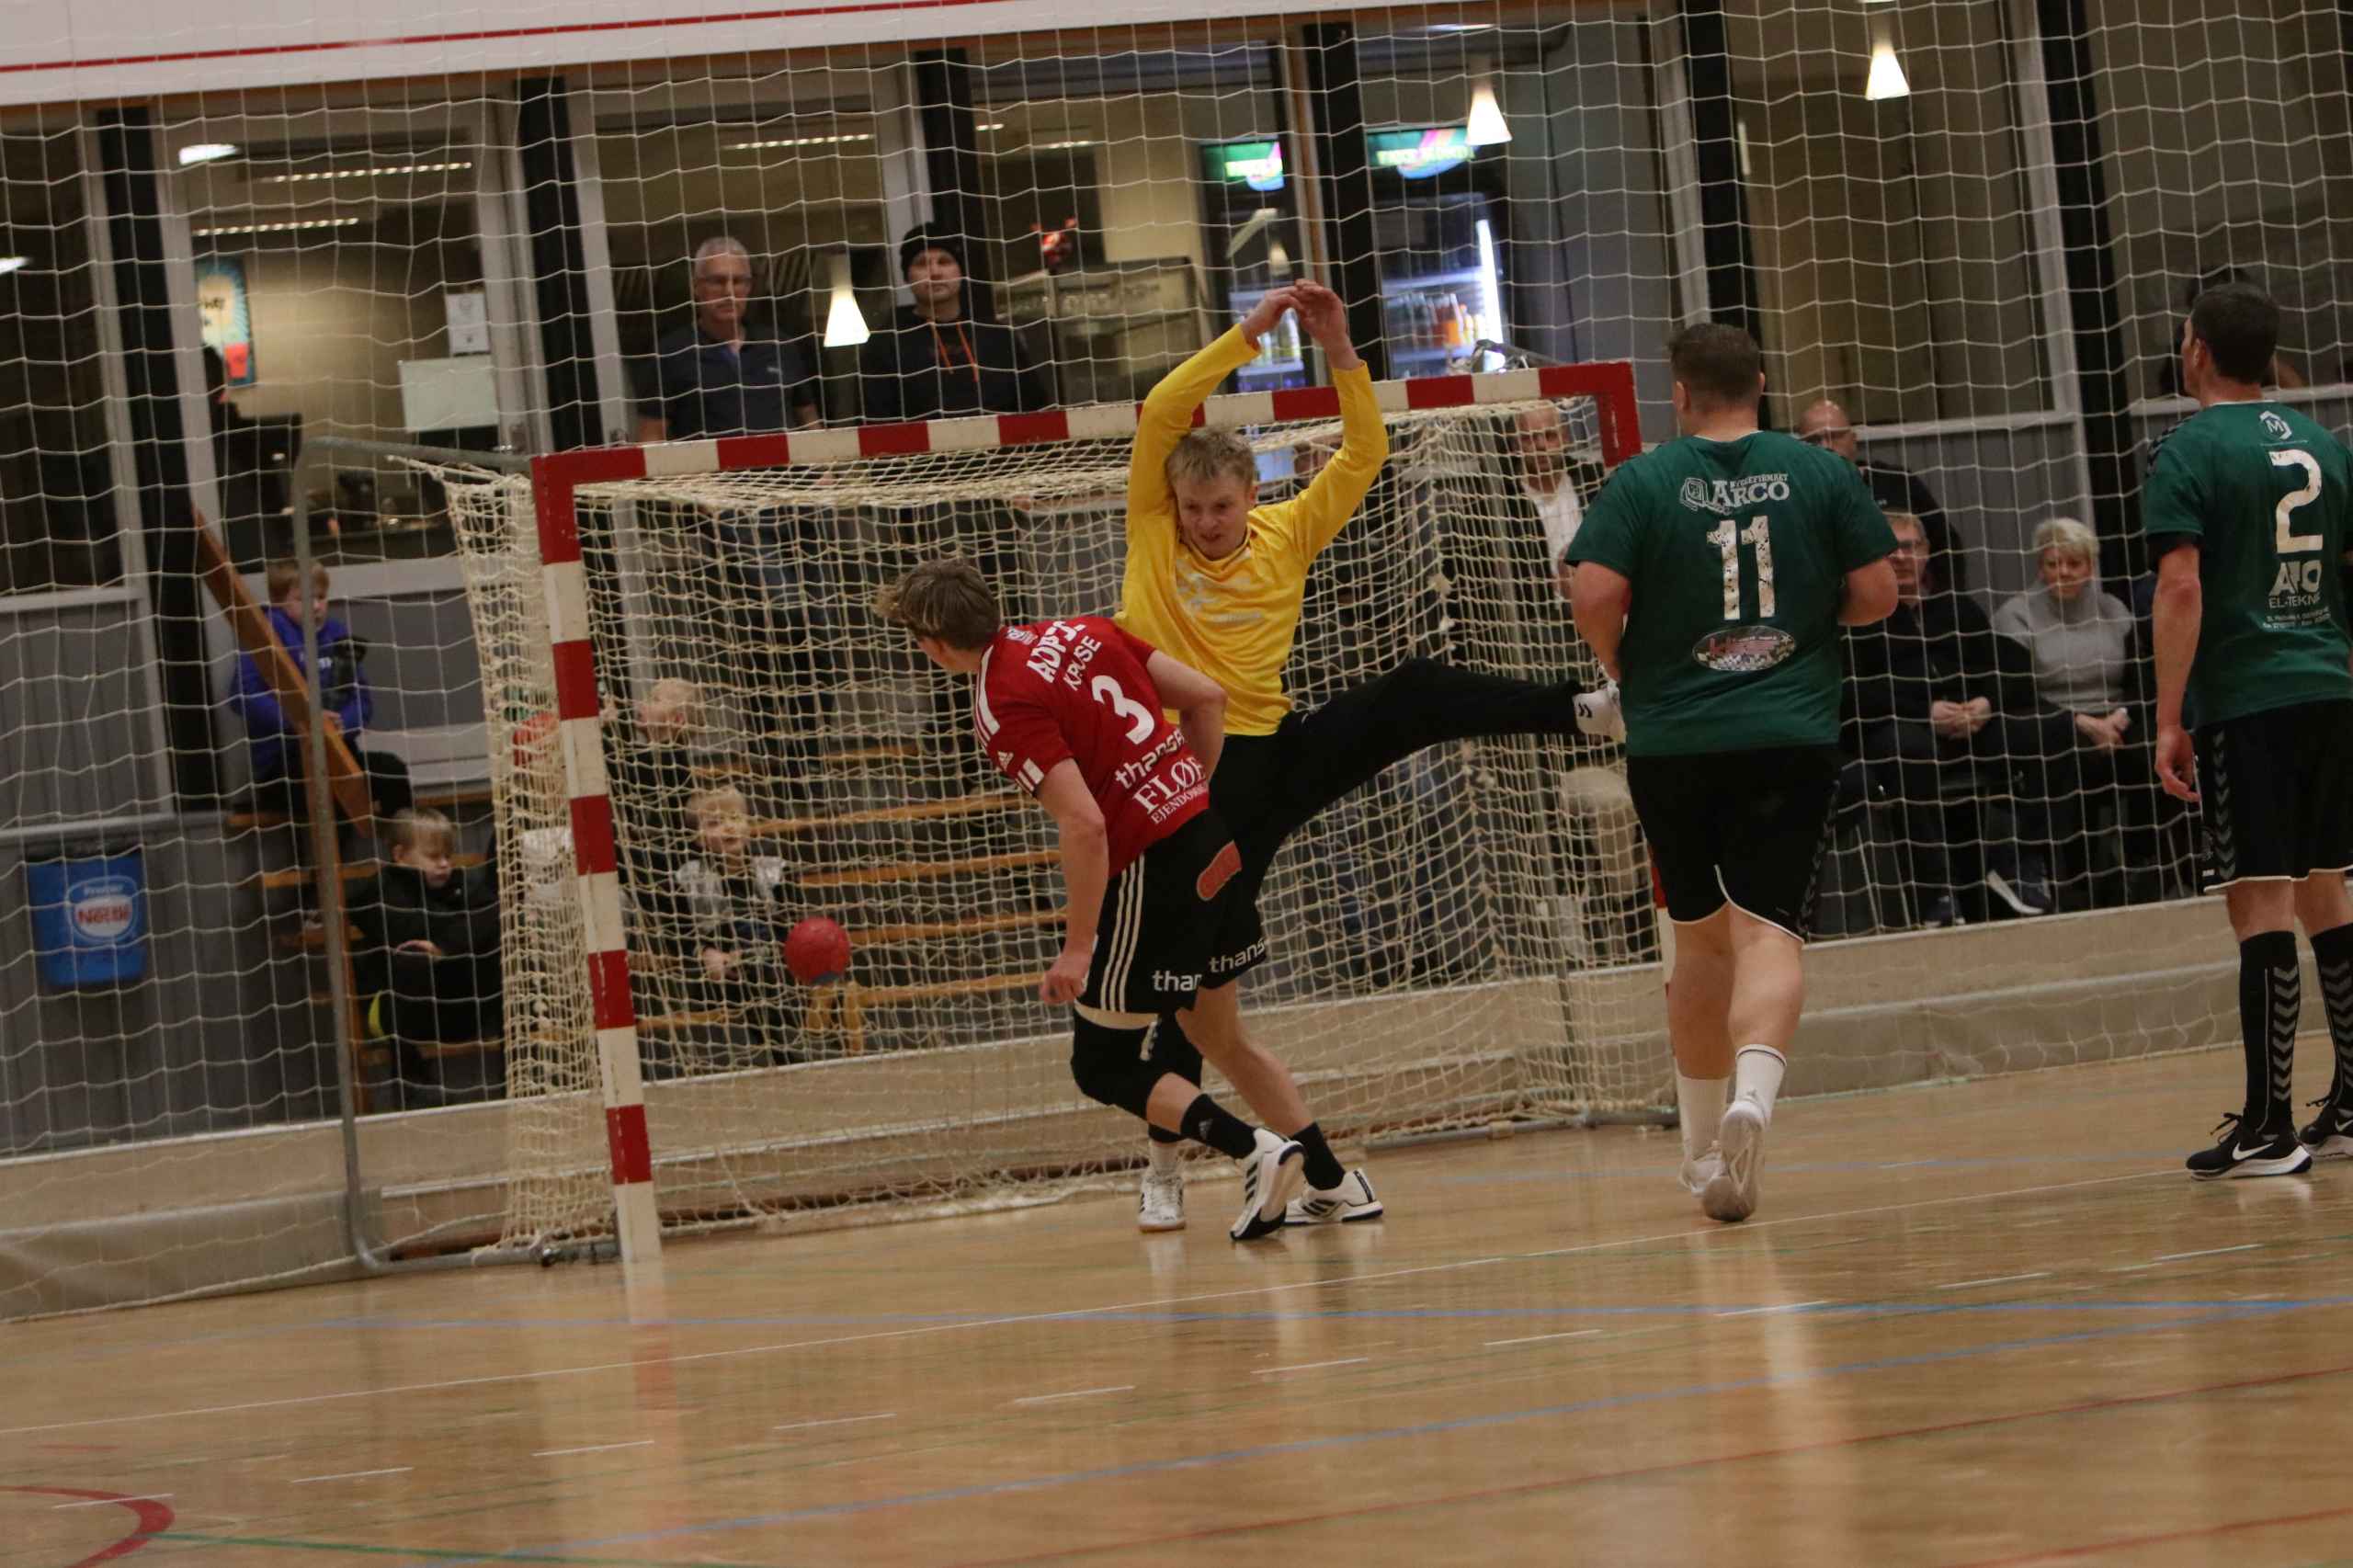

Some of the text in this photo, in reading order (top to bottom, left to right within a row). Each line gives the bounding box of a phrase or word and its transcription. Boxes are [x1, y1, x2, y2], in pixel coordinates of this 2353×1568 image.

[1711, 480, 1790, 507] ARCO
[2268, 449, 2322, 553] 2
[1706, 515, 1776, 620] 11
[1063, 635, 1102, 691] KRUSE
[1091, 675, 1154, 744] 3
